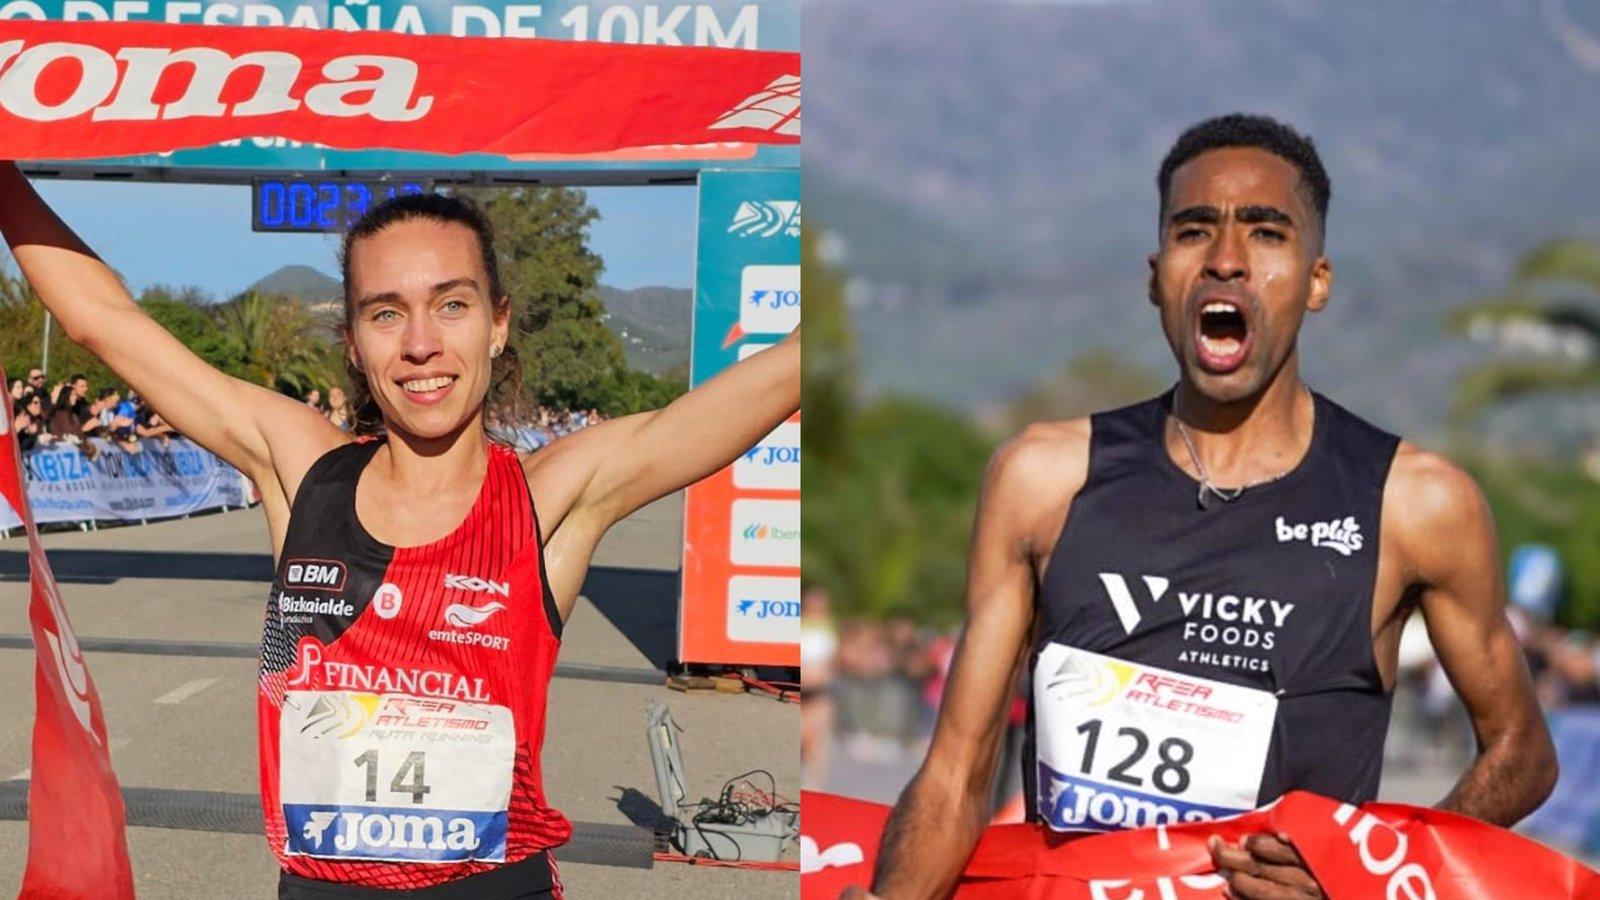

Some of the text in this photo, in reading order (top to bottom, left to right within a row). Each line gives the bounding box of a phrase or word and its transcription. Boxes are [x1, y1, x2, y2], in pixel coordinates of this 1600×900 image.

[561, 4, 758, 50] 10KM
[0, 39, 433, 122] oma
[1276, 516, 1364, 556] be plus
[303, 565, 339, 585] BM
[283, 595, 354, 617] Bizkaialde
[380, 593, 395, 610] B
[1178, 593, 1295, 628] VICKY
[428, 629, 511, 651] emteSPORT
[1183, 622, 1276, 650] FOODS
[1178, 651, 1270, 673] ATHLETICS
[323, 661, 491, 702] FINANCIAL
[1136, 673, 1213, 699] RFEA
[1126, 689, 1244, 723] ATLETISMO
[376, 715, 489, 730] ATLETISMO
[1076, 718, 1195, 795] 128
[353, 749, 431, 804] 14
